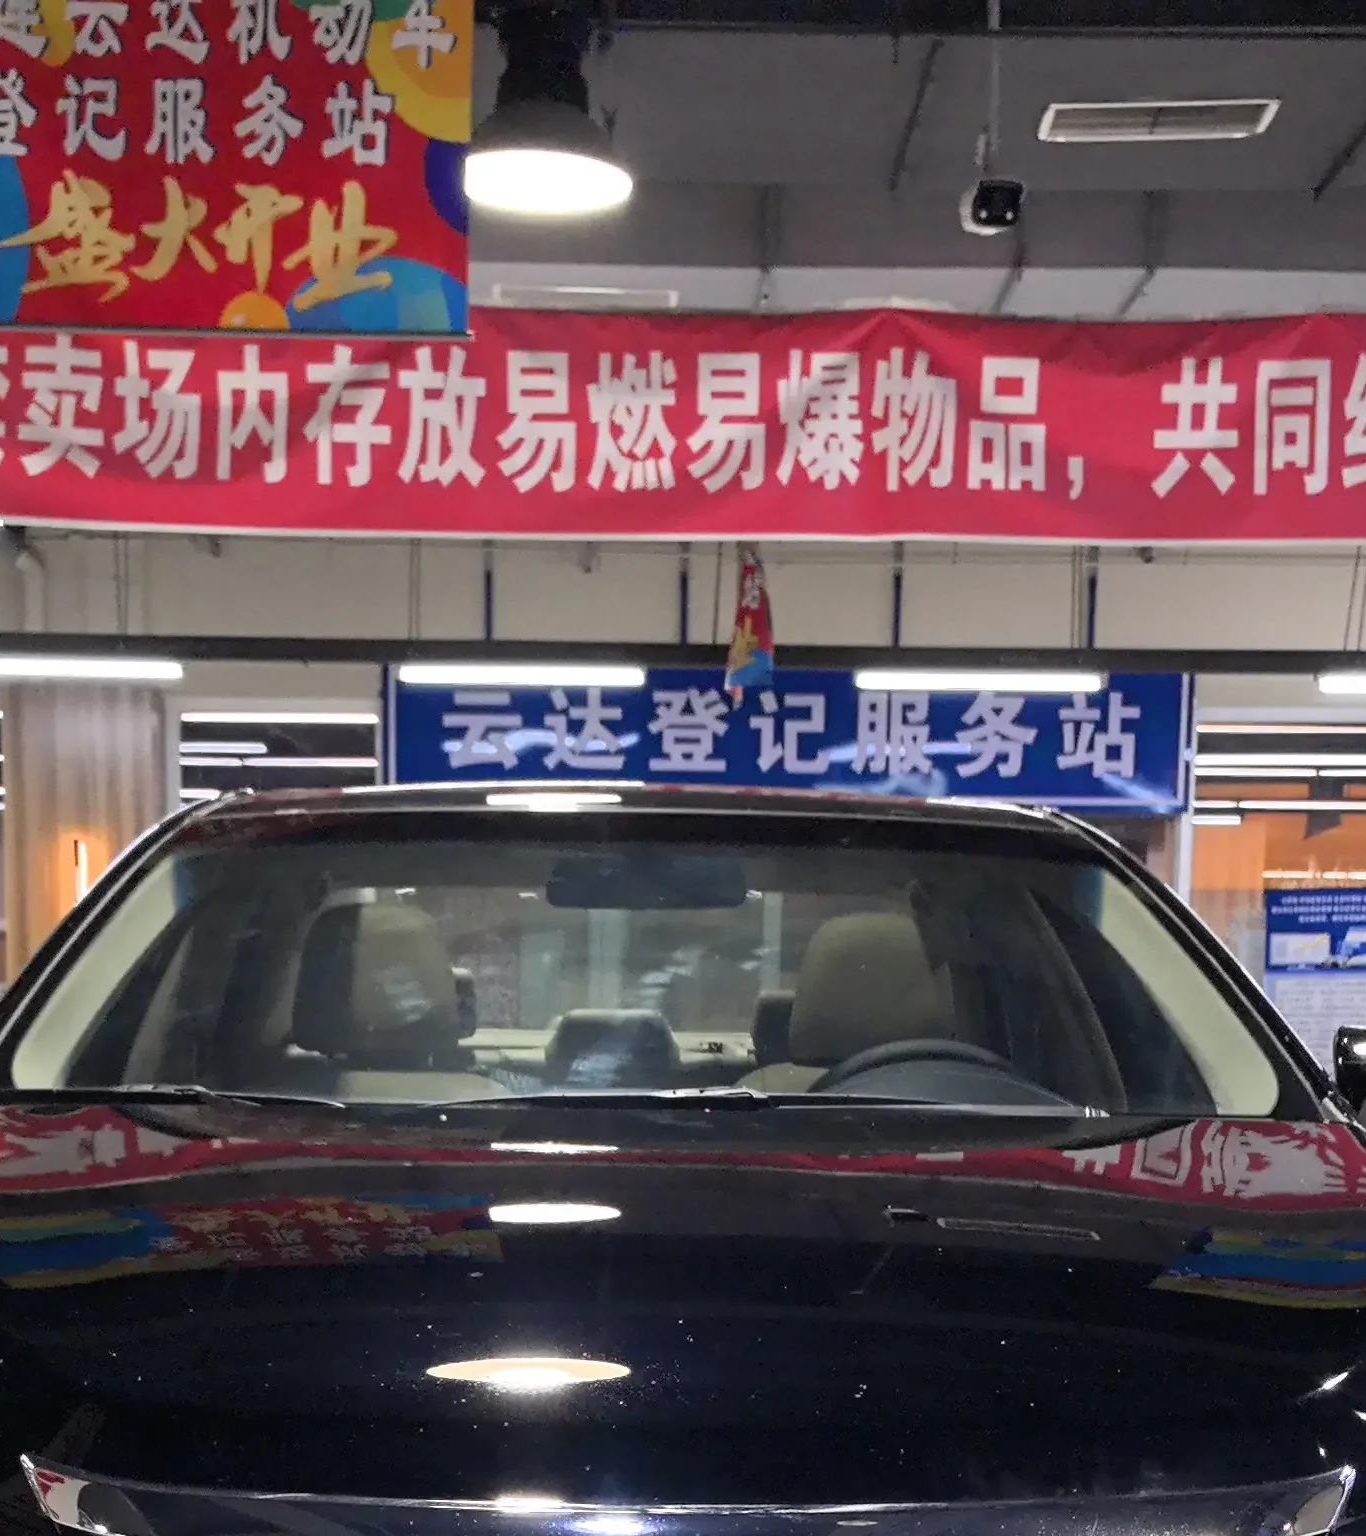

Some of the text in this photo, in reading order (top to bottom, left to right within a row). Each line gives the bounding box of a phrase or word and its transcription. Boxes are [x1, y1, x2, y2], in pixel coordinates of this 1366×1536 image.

[442, 687, 1142, 780] 云达登记服务站
